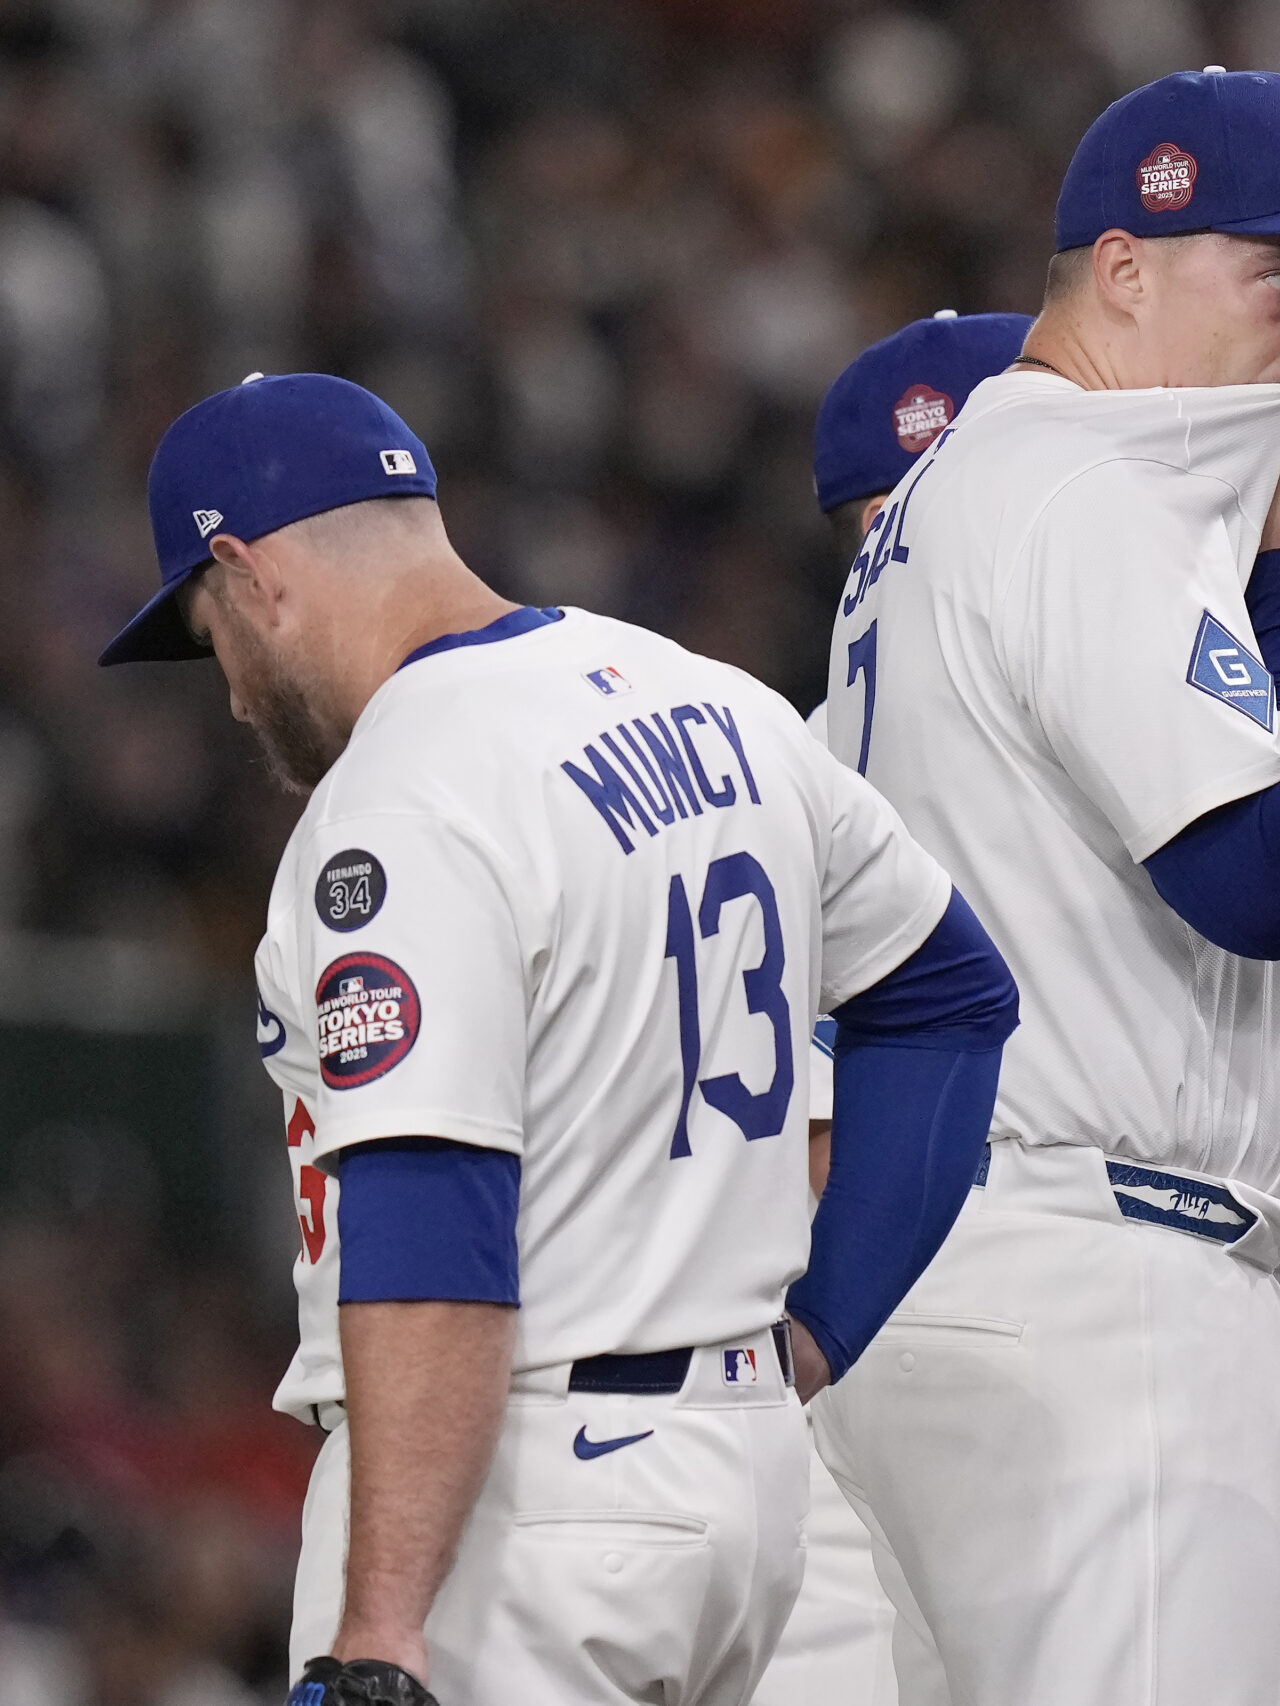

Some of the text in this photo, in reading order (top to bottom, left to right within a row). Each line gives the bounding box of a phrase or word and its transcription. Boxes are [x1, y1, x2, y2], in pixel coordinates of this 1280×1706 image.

[1141, 160, 1189, 174] MLB WORLD TOUR
[1142, 167, 1189, 184] TOKYO
[1141, 178, 1190, 195] SERIES
[896, 405, 946, 425] TOKYO
[897, 415, 949, 436] SERIES
[1209, 648, 1252, 686] G
[561, 702, 762, 855] MUNCY
[327, 862, 372, 882] FERNANDO
[329, 876, 371, 919] 34
[331, 992, 369, 1010] WORLD
[370, 986, 402, 1001] TOUR
[664, 851, 794, 1160] 13
[318, 1000, 401, 1037] TOKYO
[319, 1019, 404, 1059] SERIES
[339, 1046, 368, 1064] 2025
